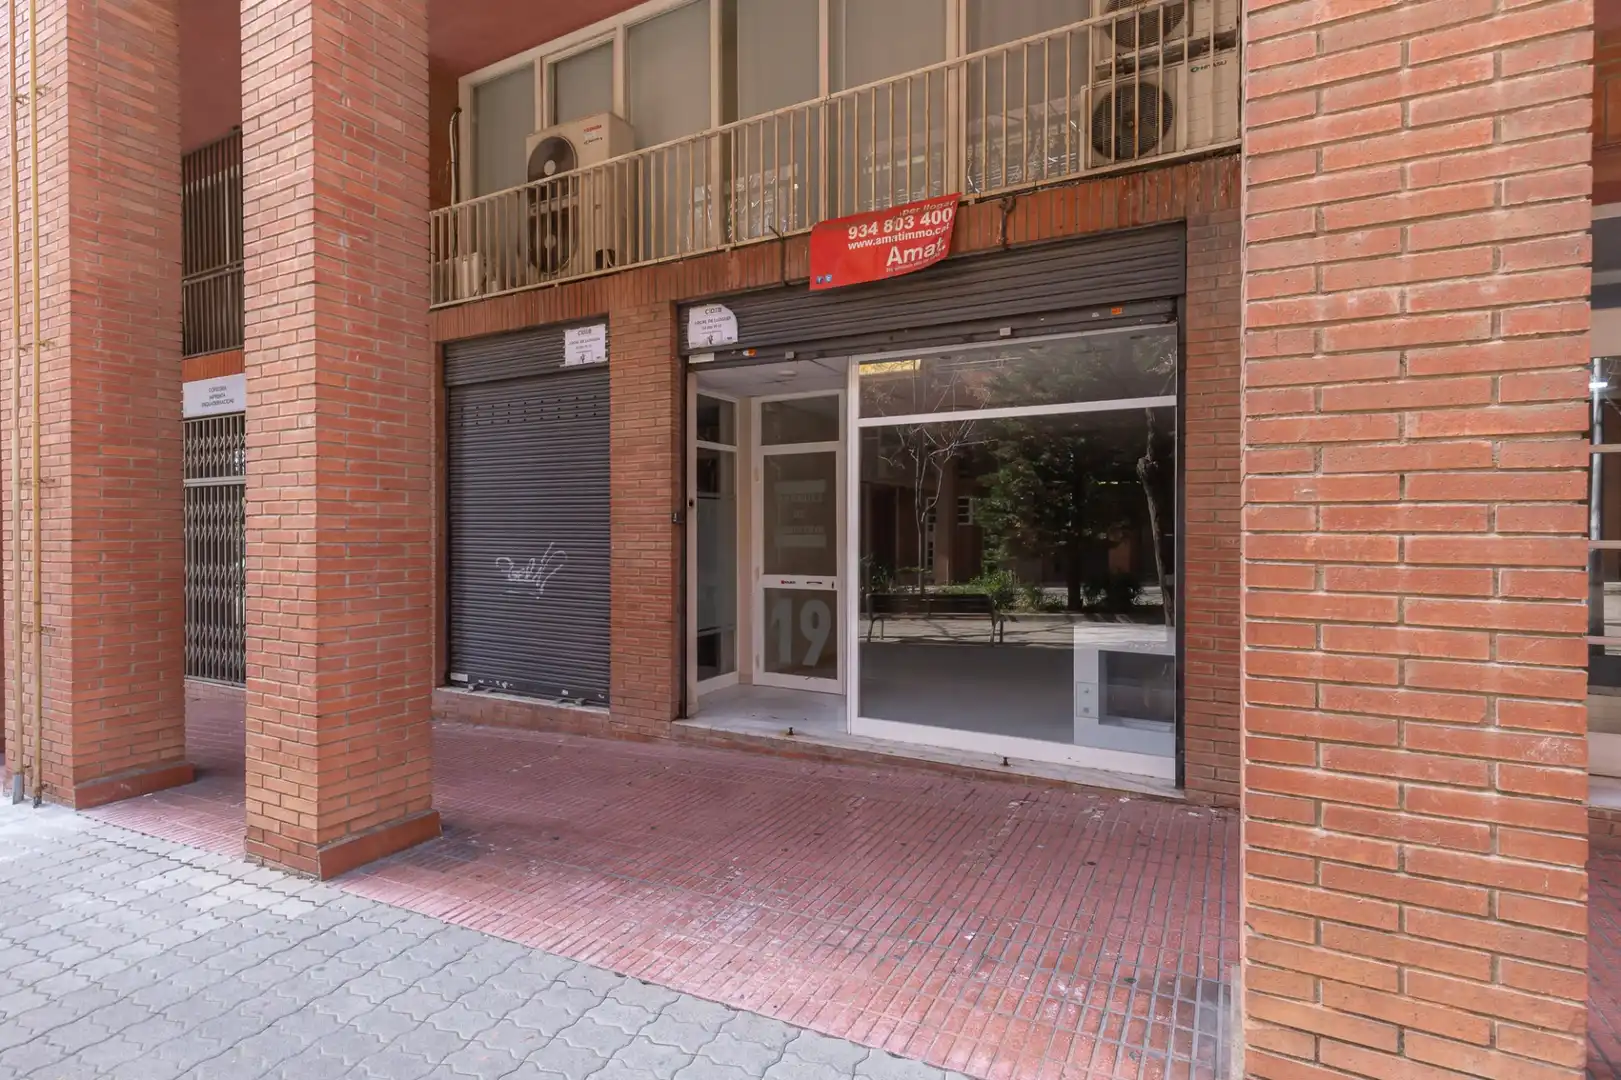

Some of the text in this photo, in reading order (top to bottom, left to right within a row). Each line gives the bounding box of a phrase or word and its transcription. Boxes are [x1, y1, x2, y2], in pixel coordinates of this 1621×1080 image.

[848, 207, 953, 240] 934 803 400
[848, 222, 949, 250] www.amatimmo.cat
[770, 598, 831, 667] 19
